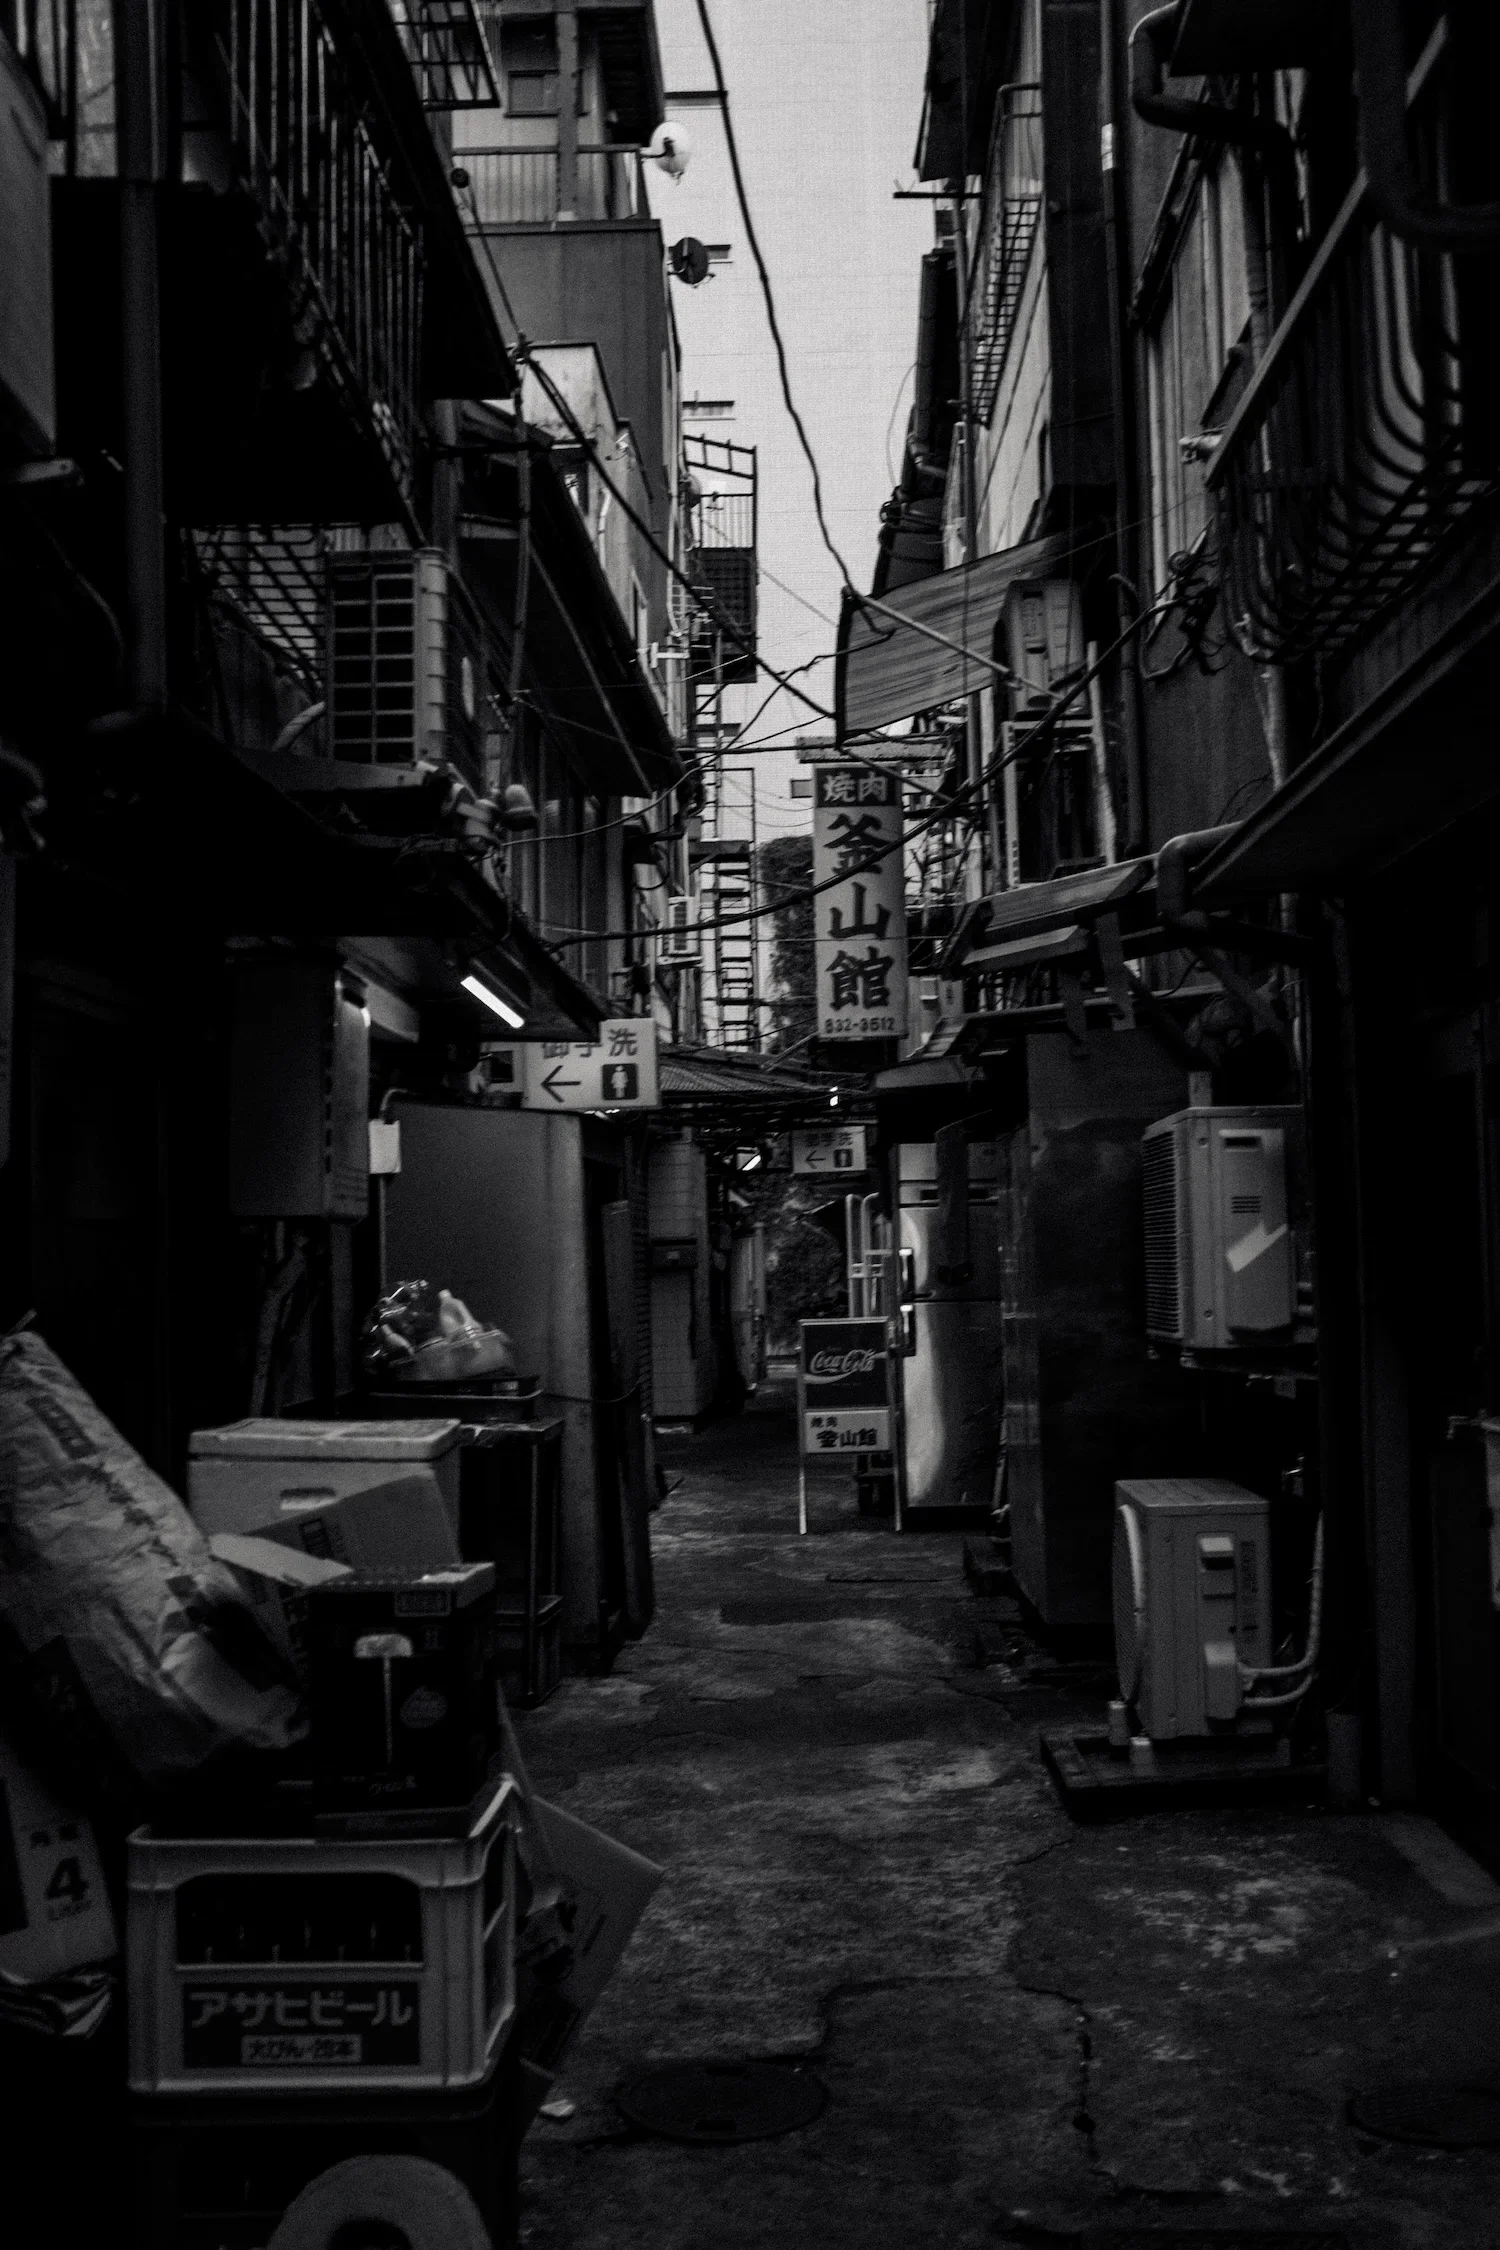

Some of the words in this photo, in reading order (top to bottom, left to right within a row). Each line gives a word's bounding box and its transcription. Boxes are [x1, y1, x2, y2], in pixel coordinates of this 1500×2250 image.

[823, 771, 888, 801] 焼肉
[823, 813, 893, 1011] 釜山館
[47, 1857, 89, 1901] 4
[188, 1989, 415, 2028] アサヒビール
